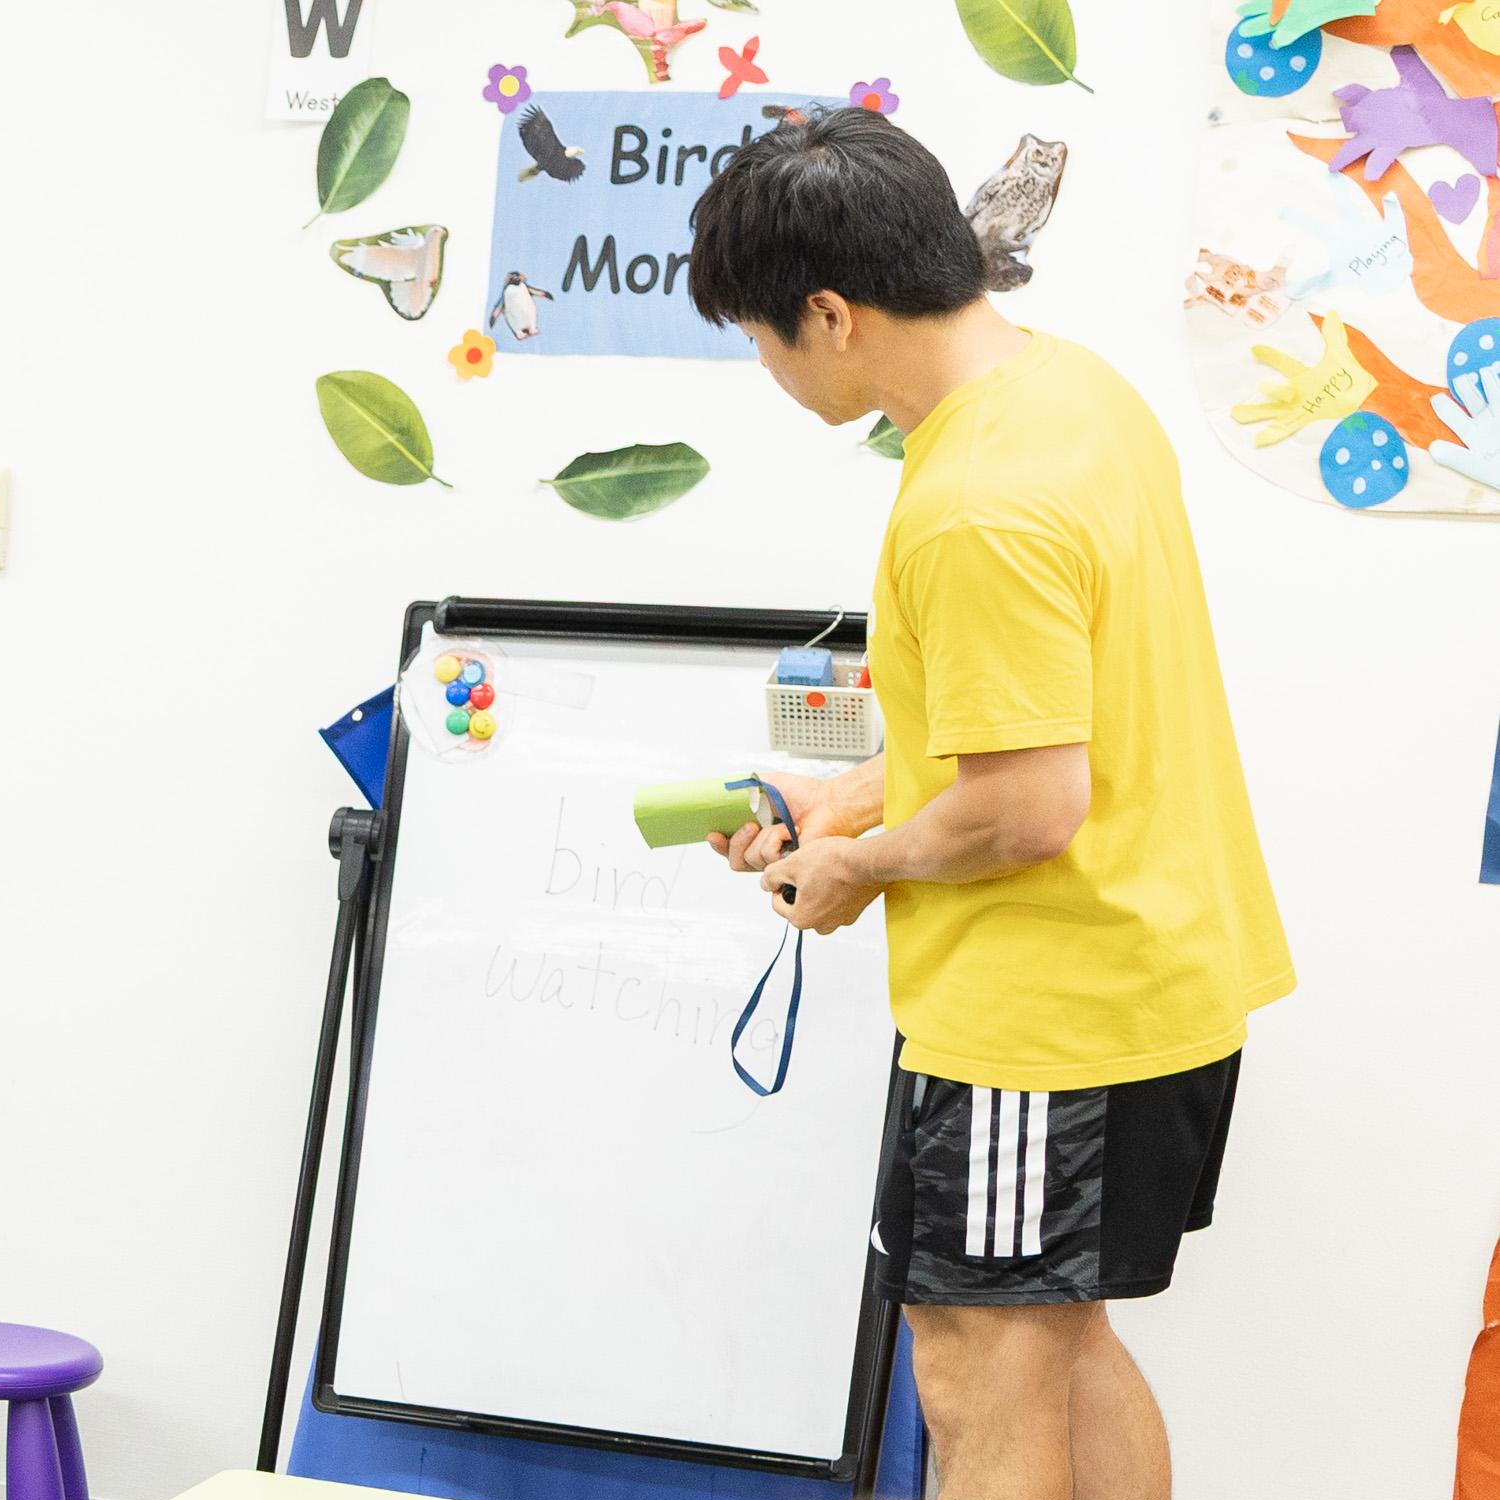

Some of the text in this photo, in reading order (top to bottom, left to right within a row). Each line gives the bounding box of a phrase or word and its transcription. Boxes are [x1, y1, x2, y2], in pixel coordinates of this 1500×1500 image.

[1348, 234, 1406, 277] Playing
[1303, 368, 1353, 414] Happy
[545, 796, 686, 932] bird
